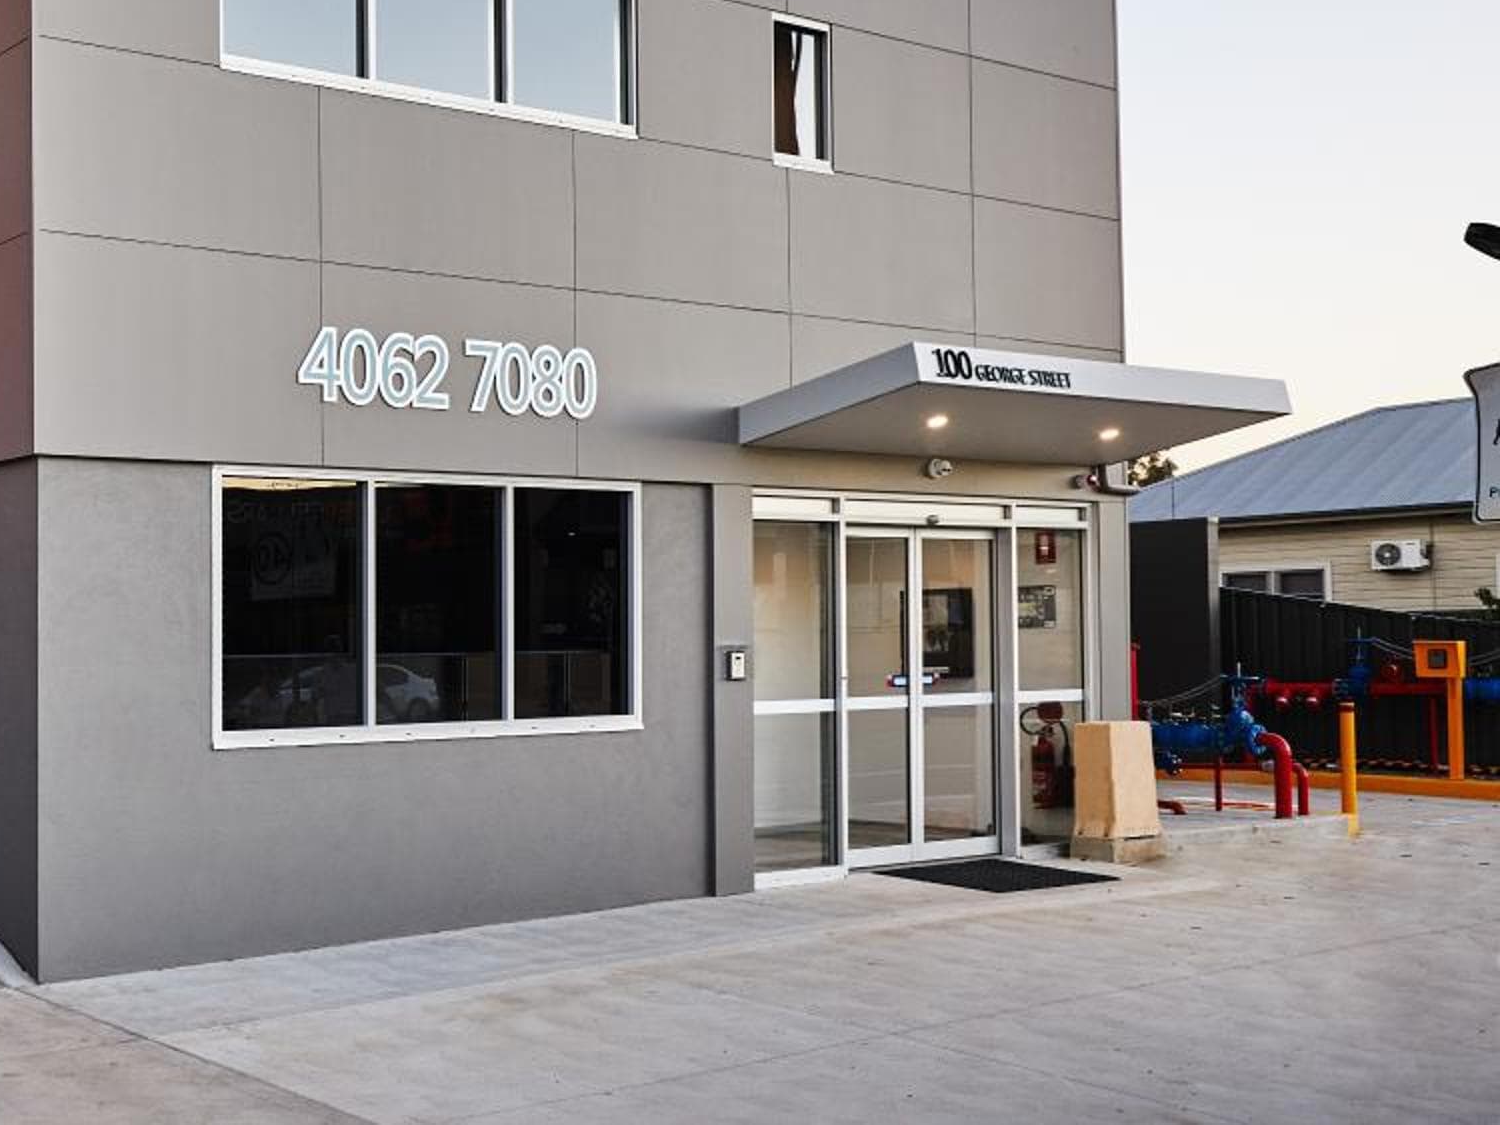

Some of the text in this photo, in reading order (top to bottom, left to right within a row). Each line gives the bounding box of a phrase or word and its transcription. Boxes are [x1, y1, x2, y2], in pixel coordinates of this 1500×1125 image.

[298, 326, 597, 419] 4062 7080
[932, 348, 1071, 389] 100 GEORGE STREET
